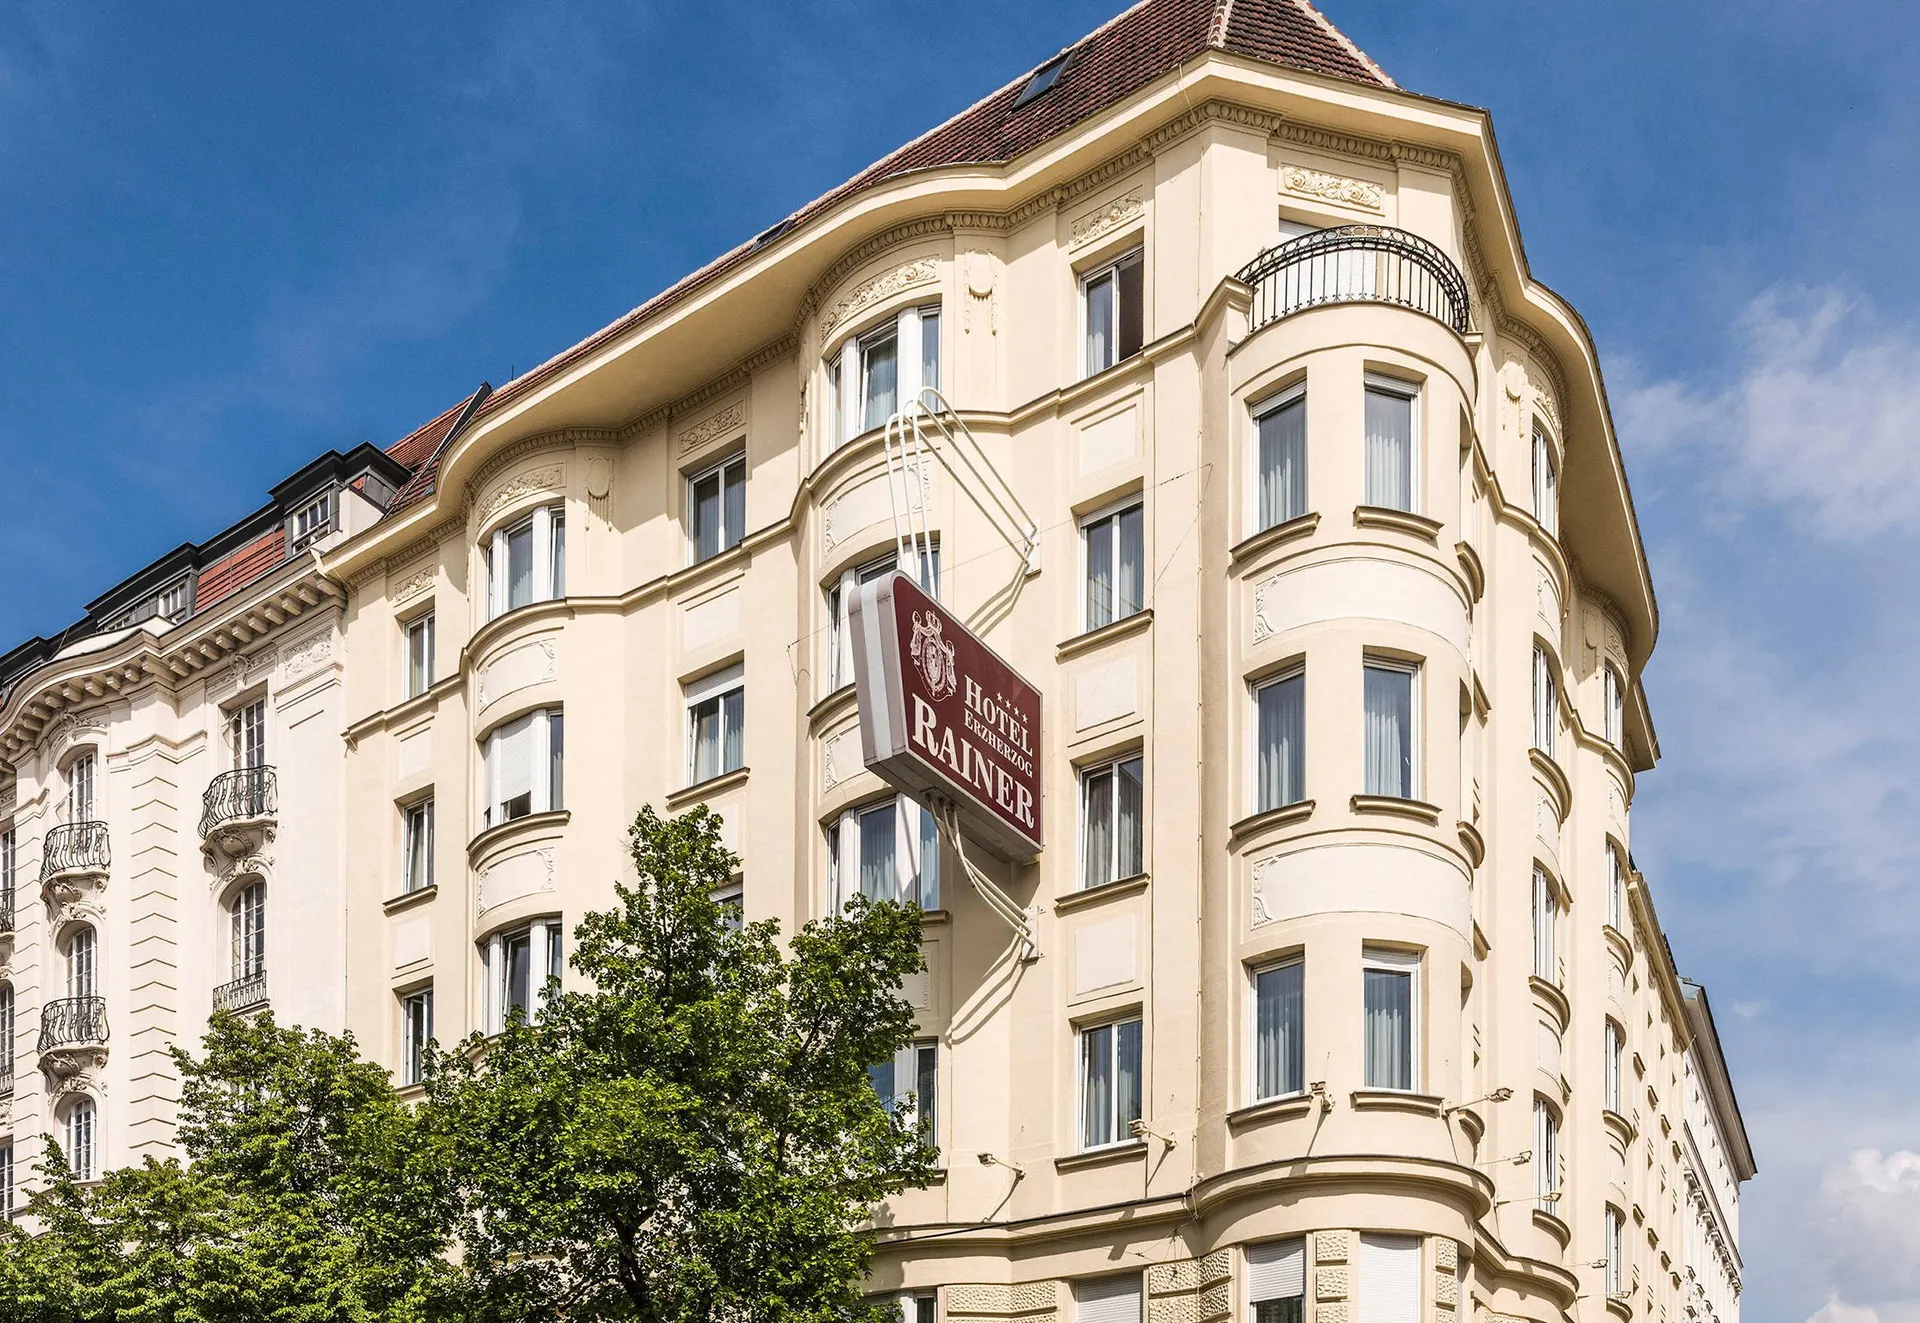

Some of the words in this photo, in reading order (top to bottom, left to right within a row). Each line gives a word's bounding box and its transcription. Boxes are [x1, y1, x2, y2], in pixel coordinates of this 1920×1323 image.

[964, 675, 1033, 757] HOTEL
[964, 708, 1033, 778] ERZHERZOG
[912, 693, 1034, 829] RAINER
